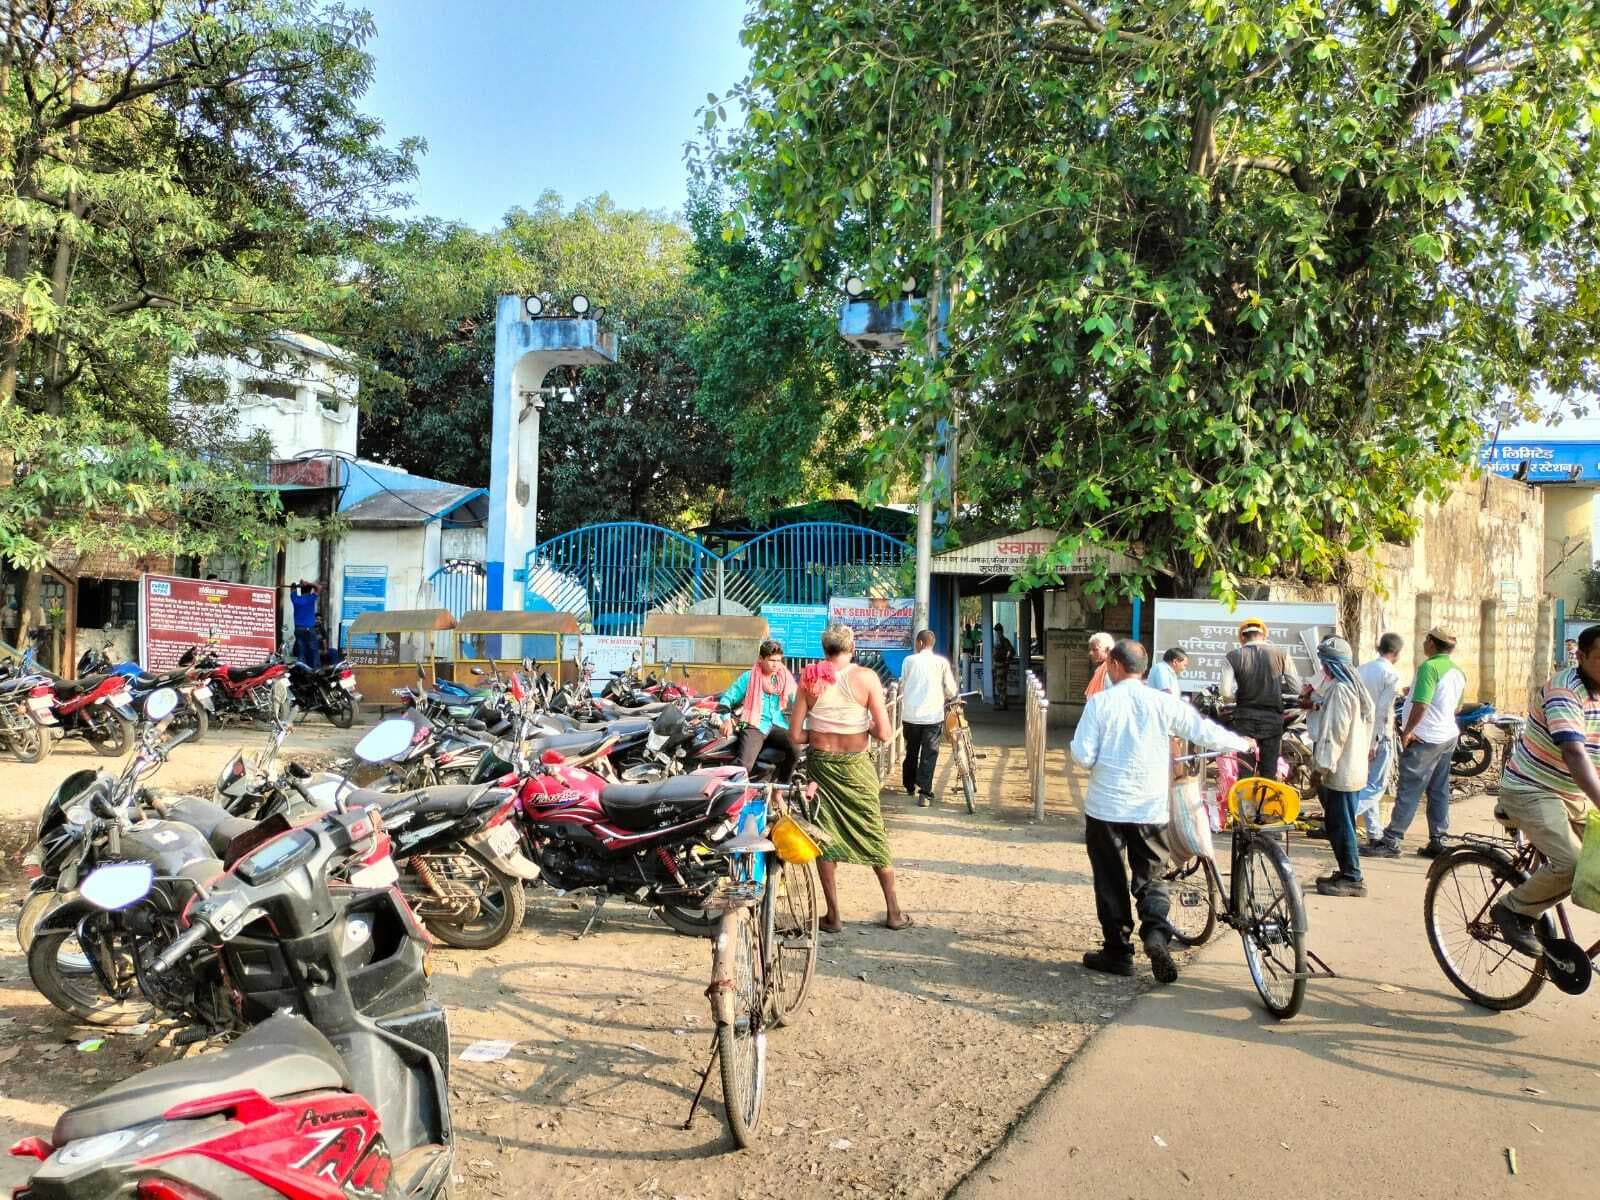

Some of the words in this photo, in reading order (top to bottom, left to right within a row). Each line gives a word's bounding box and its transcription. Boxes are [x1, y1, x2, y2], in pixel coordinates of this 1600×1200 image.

[1502, 446, 1554, 459] लिमिटेड
[1539, 461, 1572, 473] स्टेशन
[849, 607, 876, 617] SERVE
[1200, 626, 1240, 640] कृपया
[1177, 637, 1227, 652] परिचय
[1198, 657, 1222, 668] PLE
[1181, 670, 1208, 681] OUR
